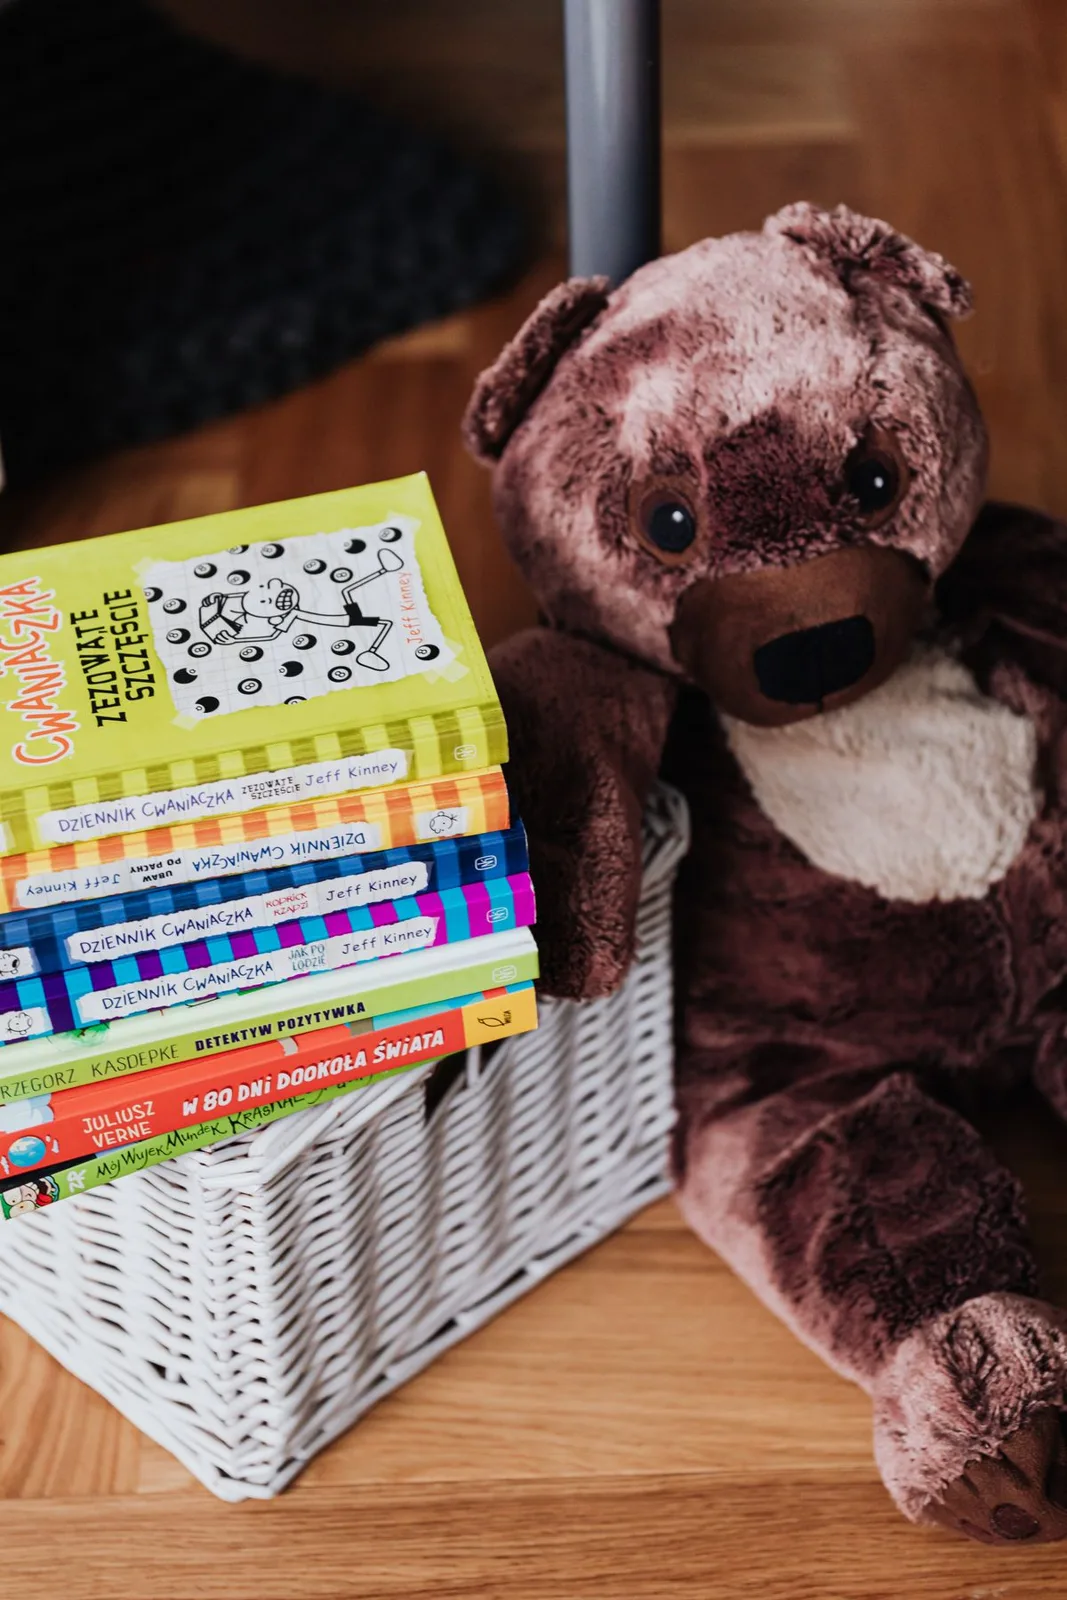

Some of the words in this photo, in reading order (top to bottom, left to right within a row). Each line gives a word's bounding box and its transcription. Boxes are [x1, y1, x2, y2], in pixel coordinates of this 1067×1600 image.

[397, 572, 414, 611] Kinney
[401, 617, 424, 645] Jeff
[70, 609, 128, 728] ZEZOWATE
[241, 776, 293, 794] ZEZOWATE
[305, 769, 340, 787] Jeff
[349, 761, 398, 778] Kinney
[129, 861, 163, 874] PACHY
[167, 857, 182, 866] PO
[26, 881, 77, 896] Kinney
[85, 873, 121, 889] Jeff
[142, 870, 173, 883] UBAW
[326, 884, 361, 901] Jeff
[369, 874, 417, 891] Kinney
[288, 946, 309, 960] JAK
[342, 938, 377, 955] Jeff
[384, 927, 432, 944] Kinney
[195, 1023, 272, 1052] DETEKTYW
[277, 1001, 366, 1033] POZYTYWKA
[91, 1044, 179, 1077] KASDEPKE
[182, 1097, 199, 1117] W
[203, 1086, 233, 1112] 80
[276, 1049, 367, 1090] DOOKOŁA
[82, 1101, 156, 1135] JULIUSZ
[92, 1122, 153, 1149] VERNE
